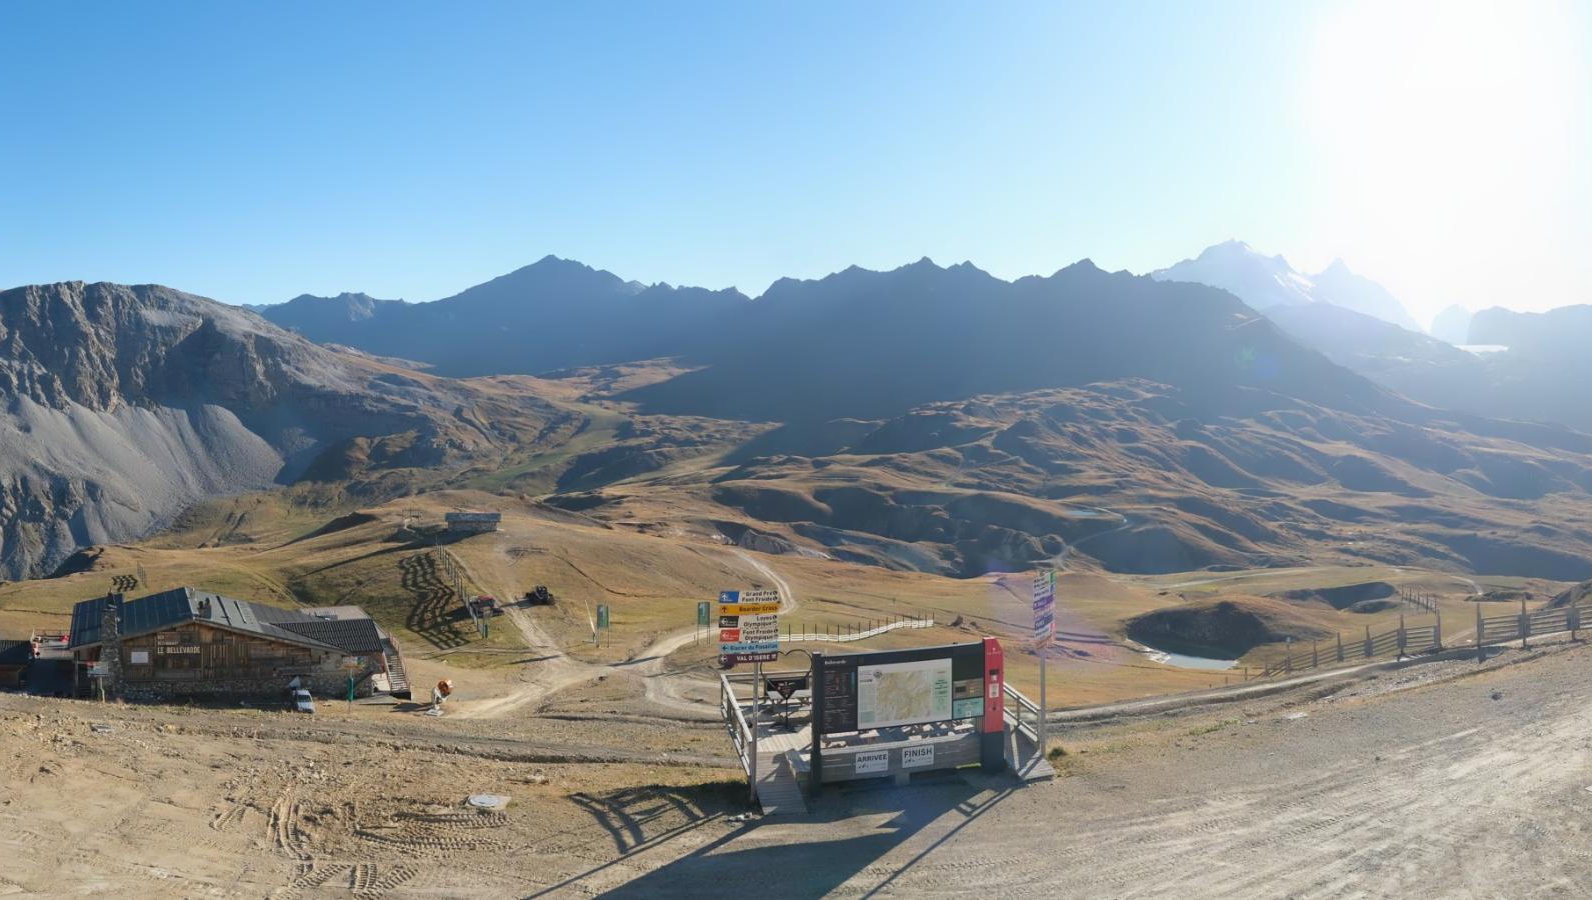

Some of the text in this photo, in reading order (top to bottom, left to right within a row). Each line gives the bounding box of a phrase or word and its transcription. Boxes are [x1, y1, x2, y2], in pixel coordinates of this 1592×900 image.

[157, 646, 201, 654] LE BELLEVARDE
[904, 747, 933, 759] FINISH
